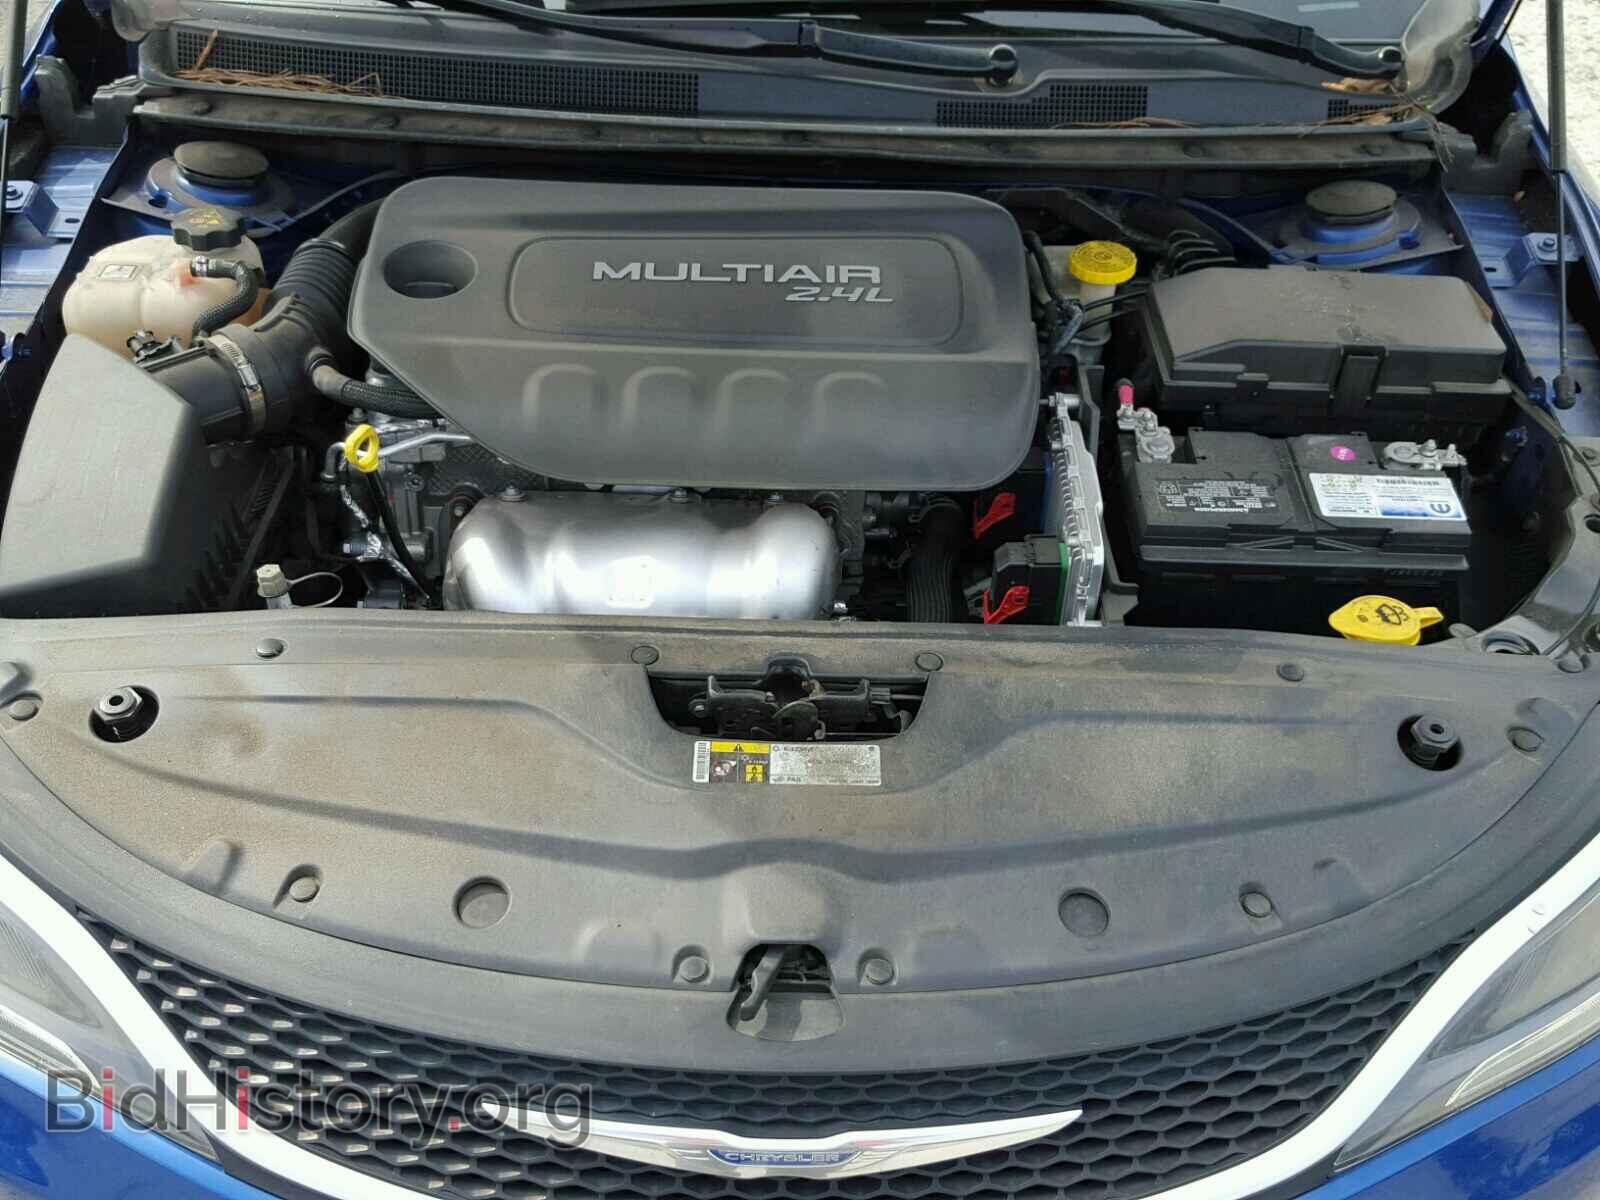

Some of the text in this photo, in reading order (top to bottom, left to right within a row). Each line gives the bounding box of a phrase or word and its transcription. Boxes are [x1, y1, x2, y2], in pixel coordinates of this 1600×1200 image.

[592, 262, 882, 284] MULTIAIR
[785, 286, 894, 302] 2.4L
[724, 1152, 841, 1163] CHRYSLER
